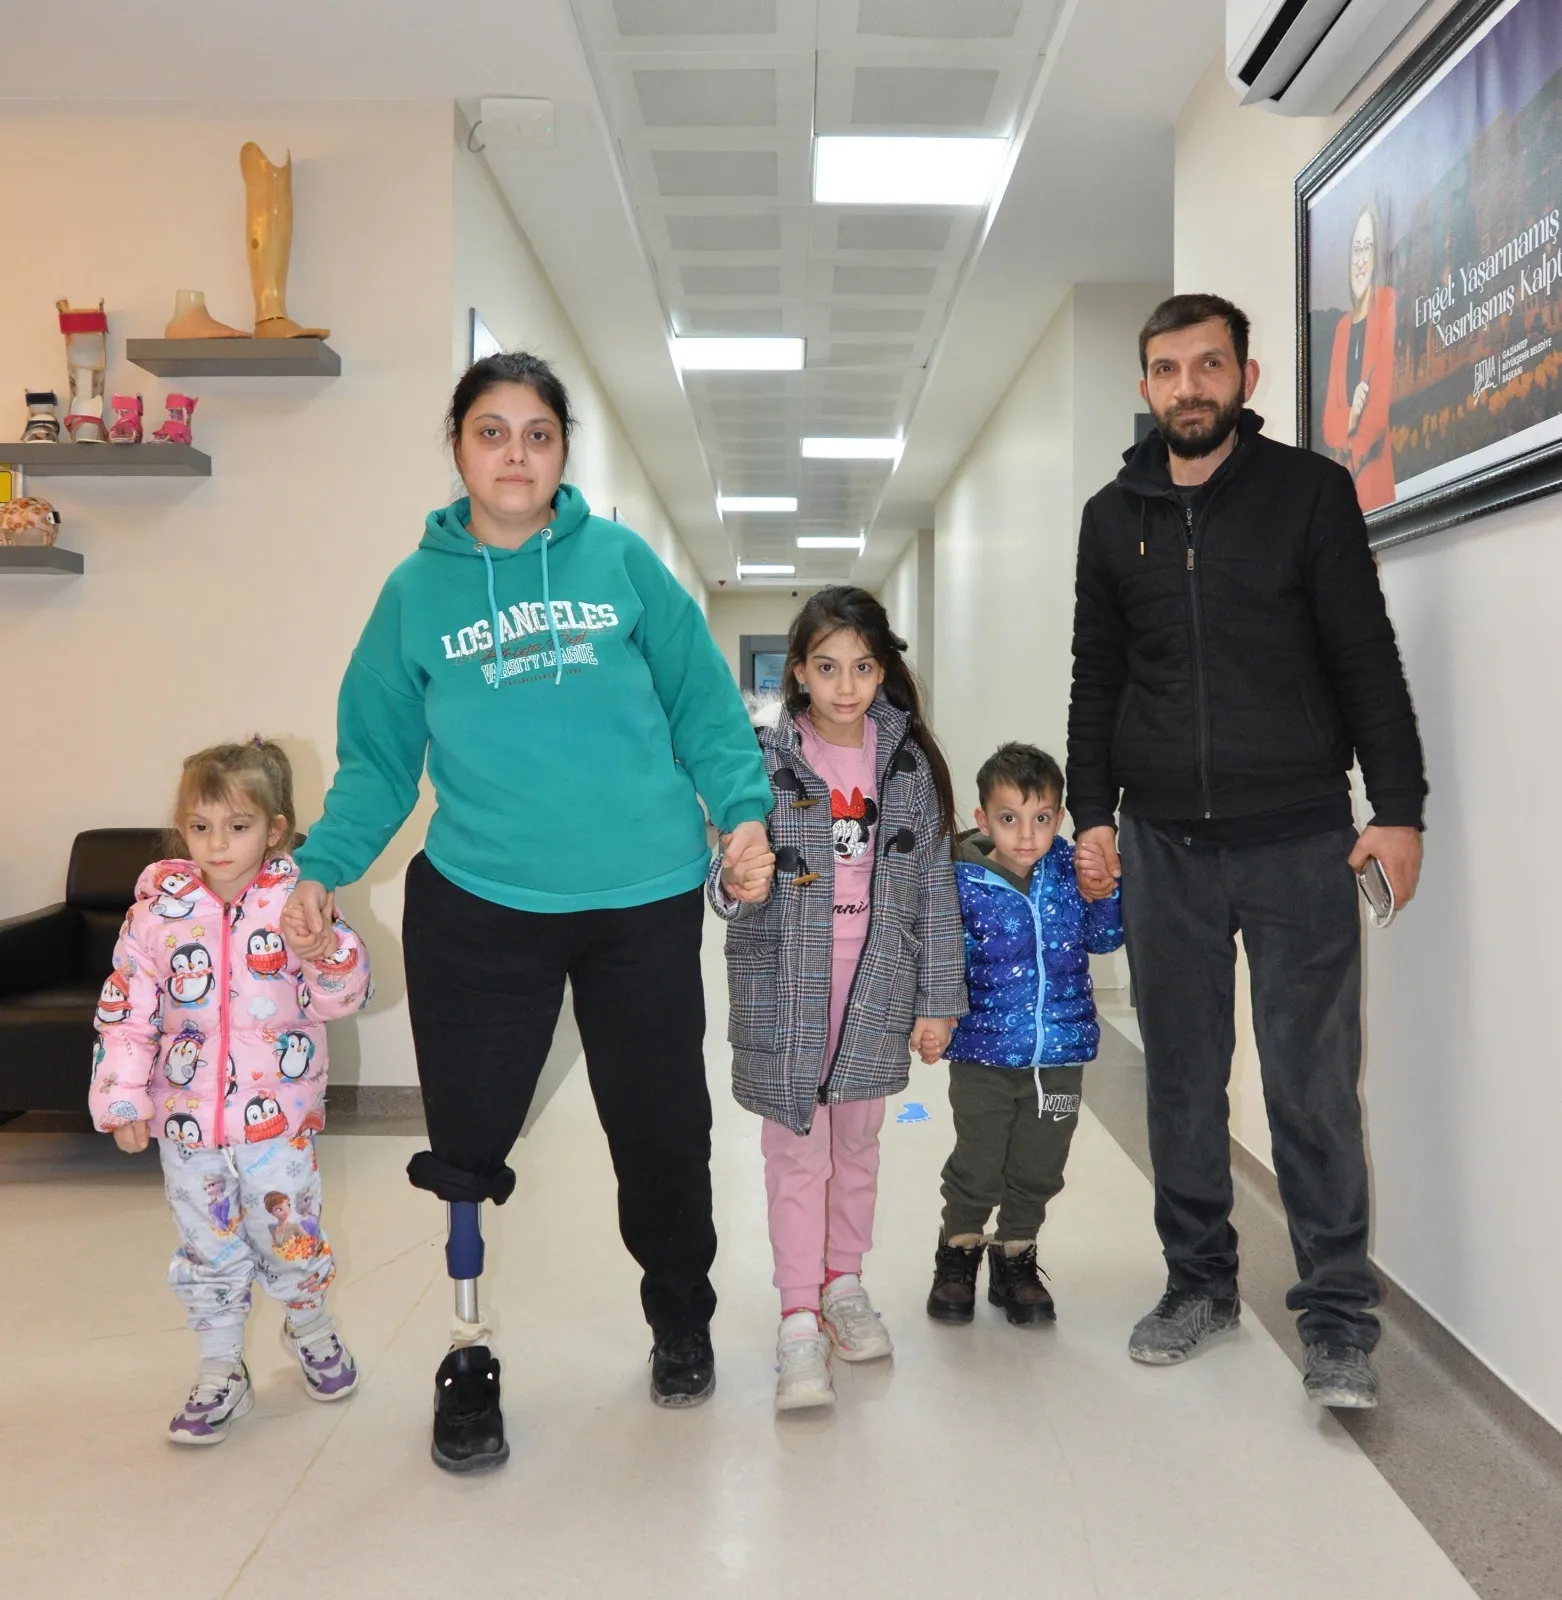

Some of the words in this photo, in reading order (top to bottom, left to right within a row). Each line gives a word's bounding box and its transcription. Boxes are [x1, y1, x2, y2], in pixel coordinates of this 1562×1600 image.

[1415, 272, 1455, 329] Engel:
[1460, 209, 1560, 296] Yaşarmamış
[1435, 284, 1515, 352] Nasırlaşmış
[1530, 337, 1552, 357] BELEDİYE
[441, 619, 493, 659] LOS
[497, 600, 619, 644] ANGELES
